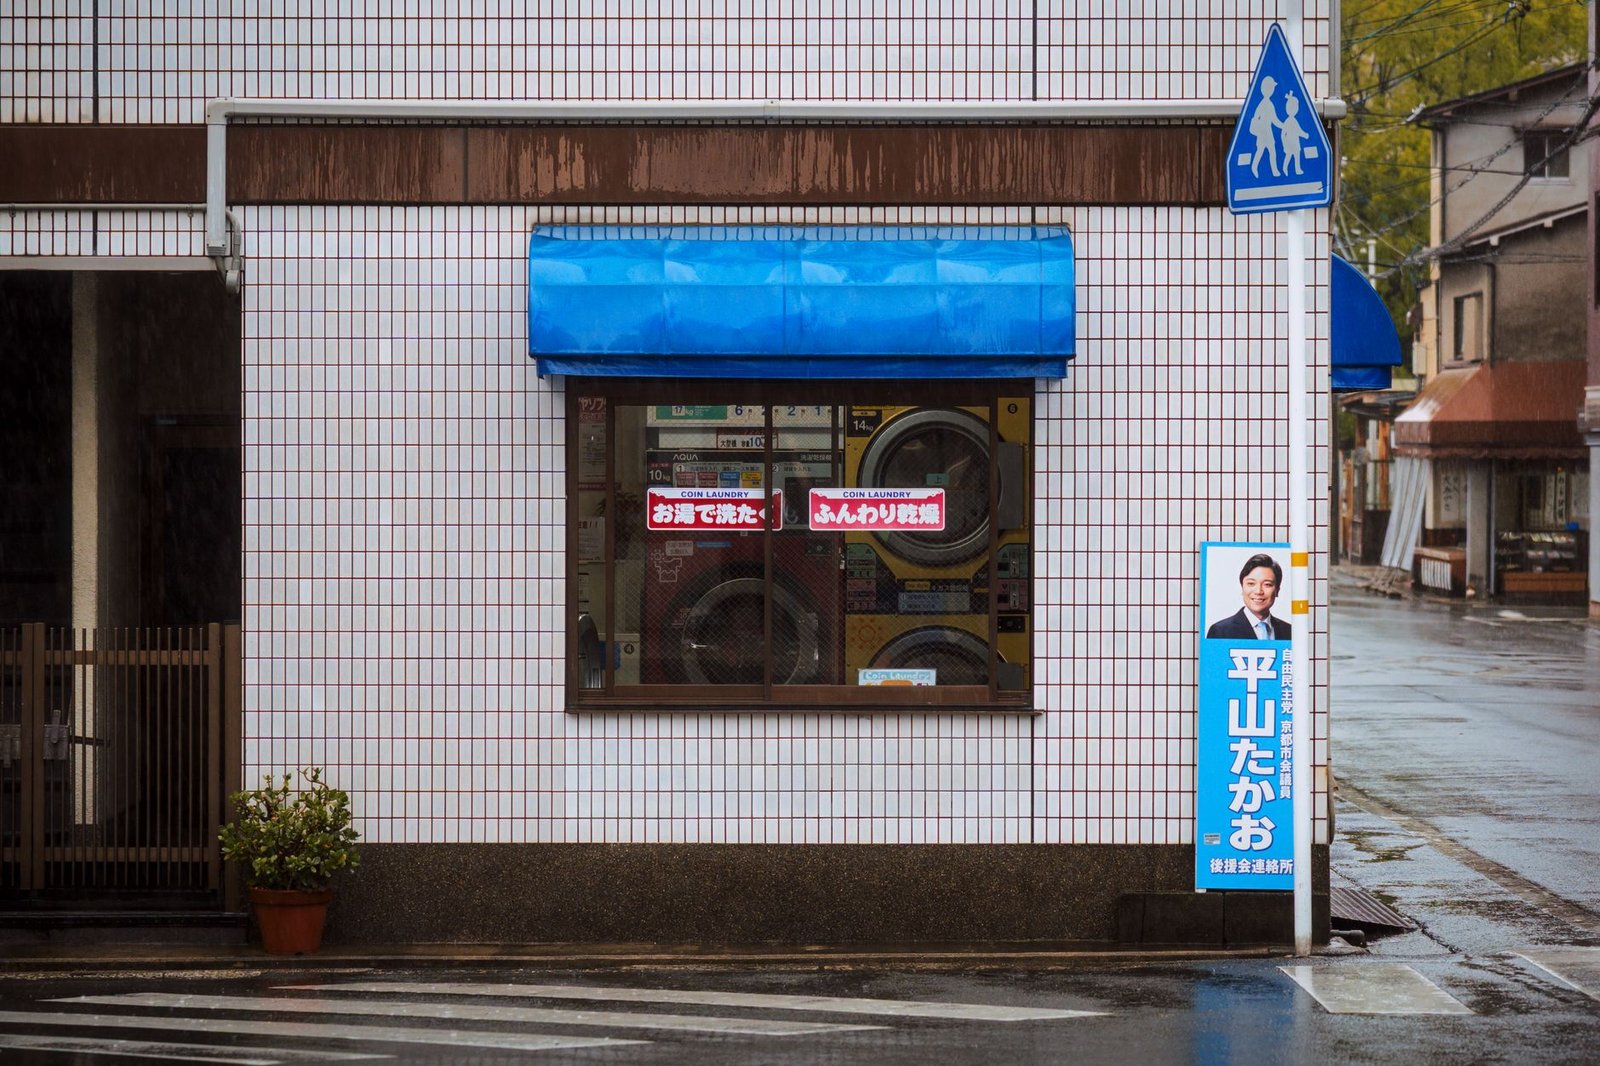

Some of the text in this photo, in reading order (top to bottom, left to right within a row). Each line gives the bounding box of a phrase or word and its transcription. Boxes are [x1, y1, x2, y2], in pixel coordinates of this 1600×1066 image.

[672, 453, 699, 461] AQUA
[649, 469, 671, 481] 10kg
[814, 503, 940, 525] ふんわり乾燥
[865, 672, 930, 681] Coin Laundry
[1279, 648, 1294, 800] 自由民主党 京都市会議員
[1227, 647, 1279, 852] 平山たかお
[1209, 858, 1294, 874] 後援会連絡所
